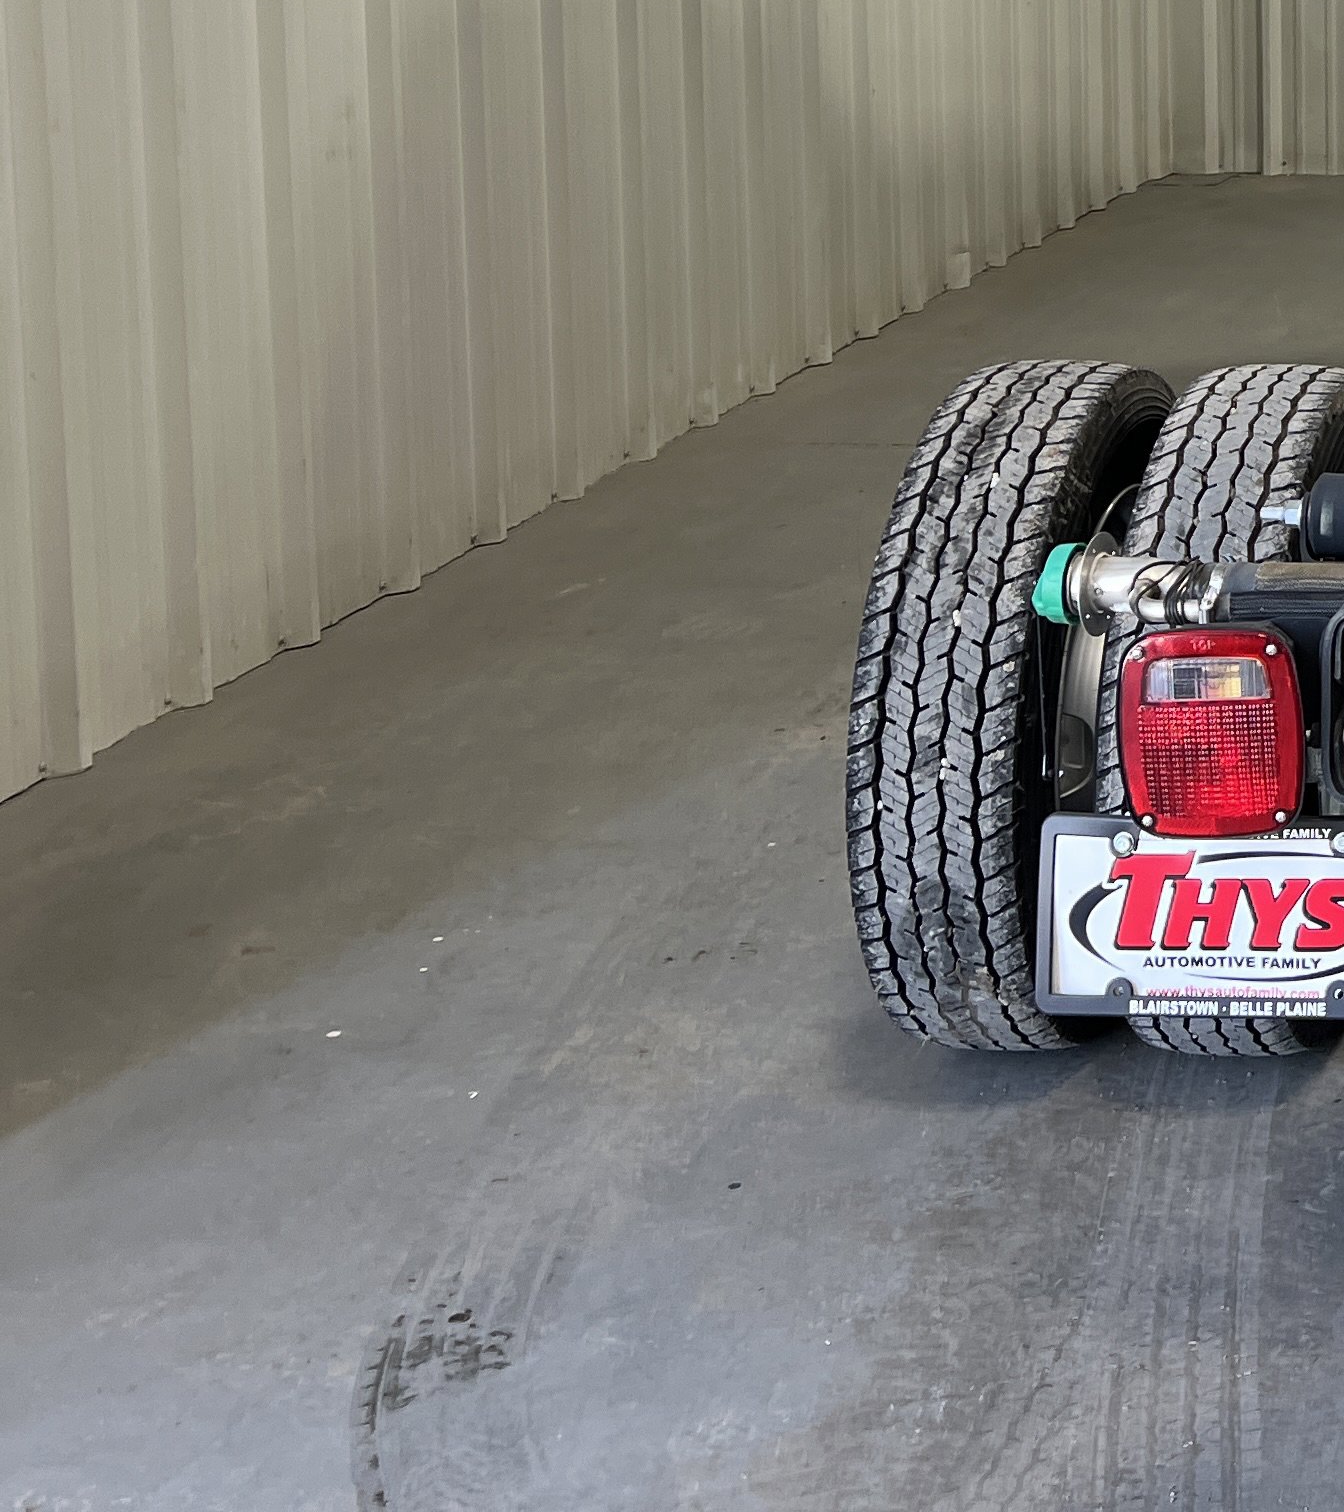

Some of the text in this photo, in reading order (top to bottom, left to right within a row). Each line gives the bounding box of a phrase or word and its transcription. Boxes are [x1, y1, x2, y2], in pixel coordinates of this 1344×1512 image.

[1283, 828, 1332, 839] FAMILY
[1143, 956, 1322, 969] AUTOMOTIVE FAMILY
[1146, 984, 1320, 999] www.thysautofamily.com
[1129, 1000, 1327, 1017] BLAIRSTOWN BELLE PLAINE
